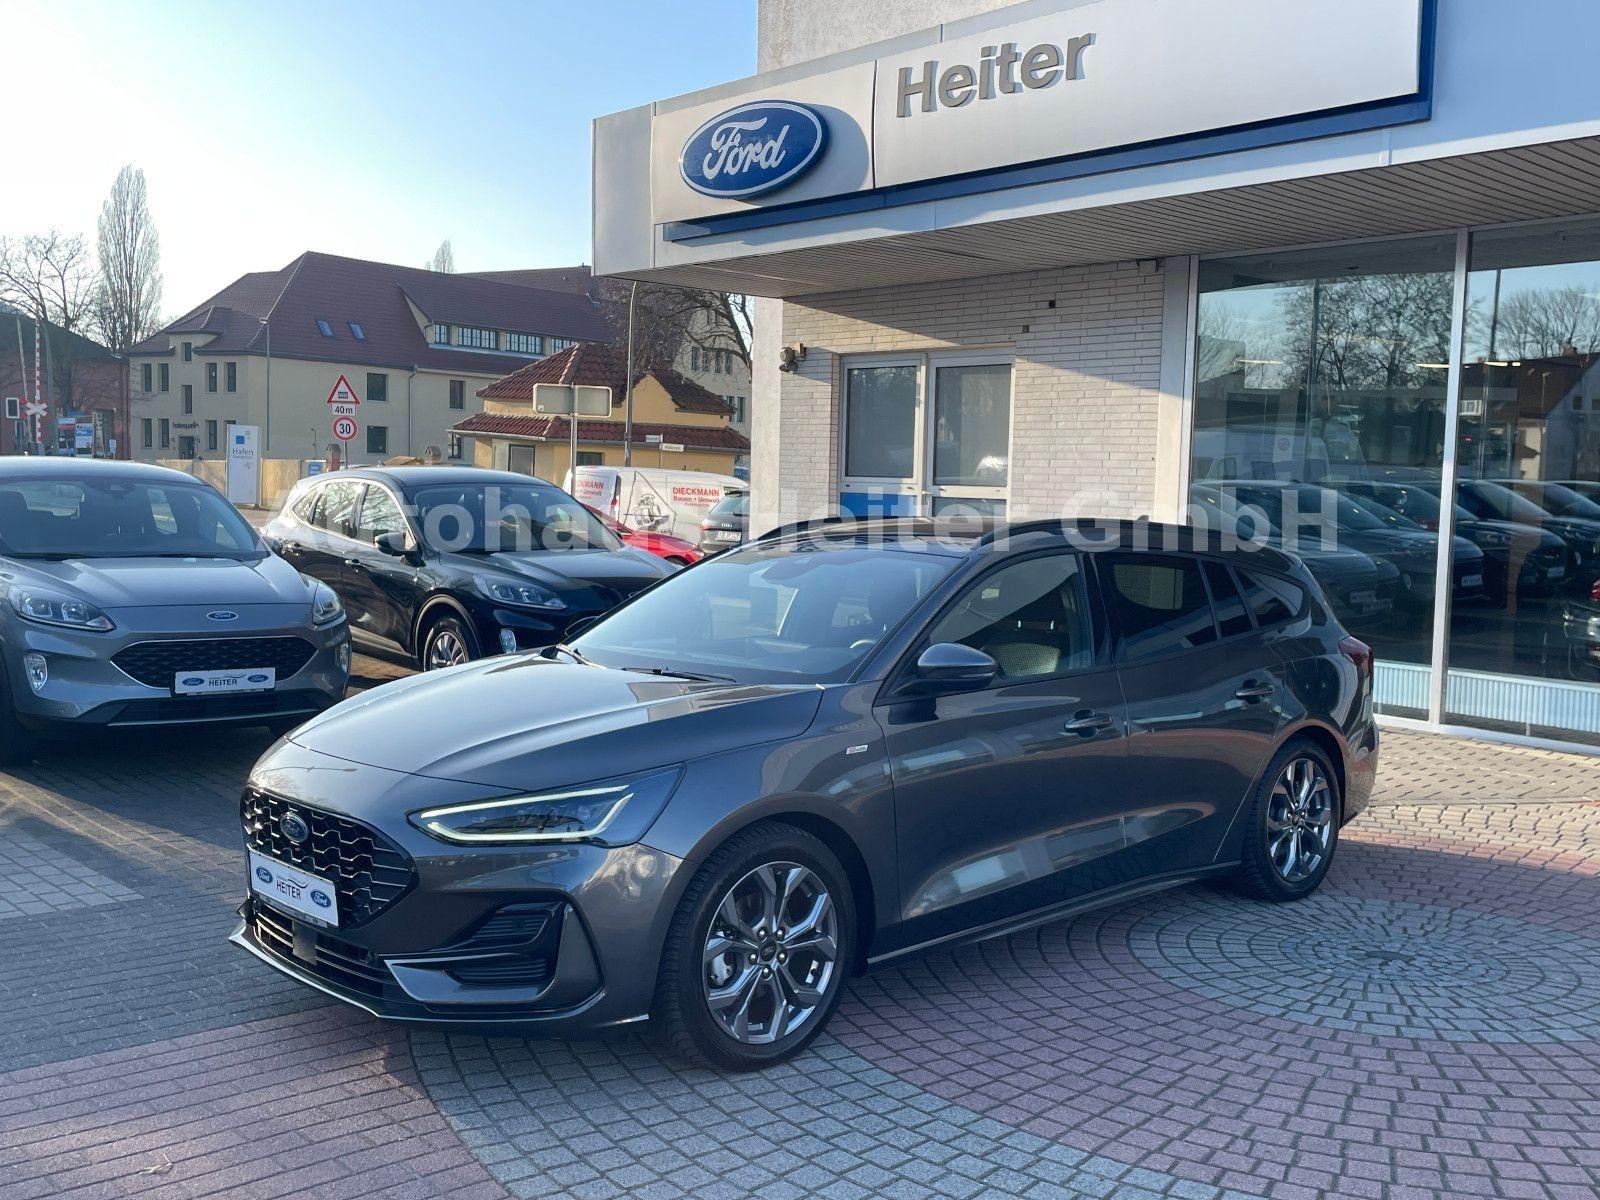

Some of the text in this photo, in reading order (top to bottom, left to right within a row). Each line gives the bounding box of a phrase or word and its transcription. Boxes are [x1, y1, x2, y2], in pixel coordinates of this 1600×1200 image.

[896, 33, 1094, 118] Heiter
[702, 115, 789, 180] Ford
[339, 423, 351, 435] 30
[672, 486, 720, 496] DIECKMANN
[208, 678, 238, 687] HEITER
[276, 880, 301, 900] HEITER
